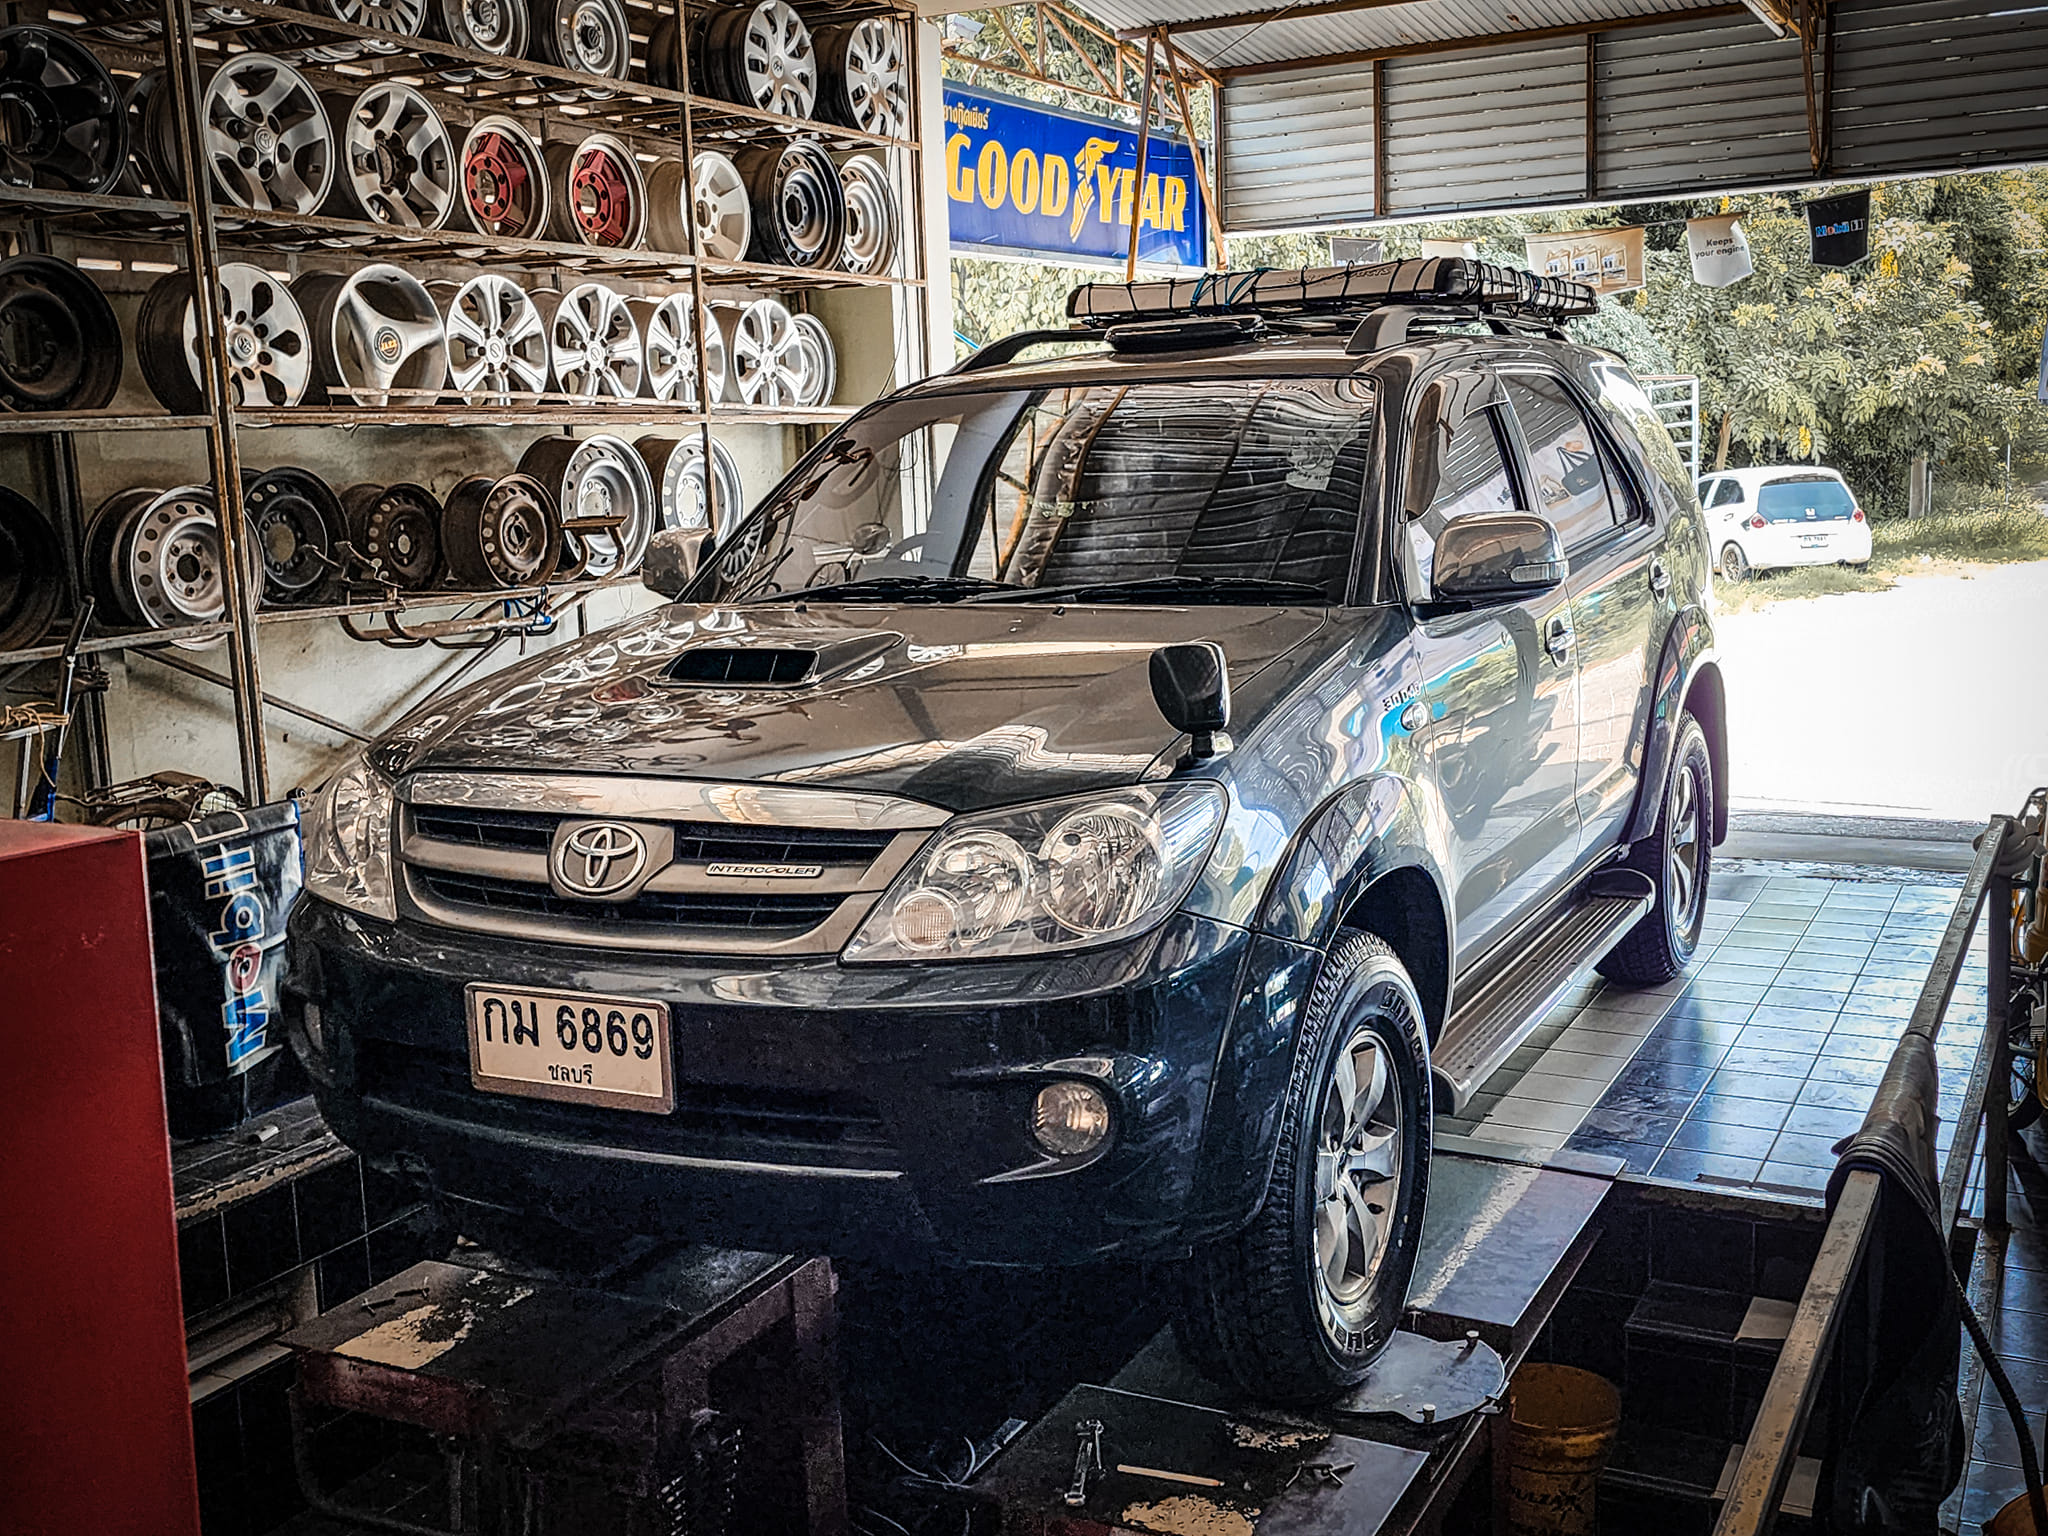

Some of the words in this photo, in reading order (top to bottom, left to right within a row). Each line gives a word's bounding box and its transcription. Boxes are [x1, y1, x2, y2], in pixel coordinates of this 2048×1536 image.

[1816, 221, 1850, 237] Mobil
[1706, 238, 1733, 247] Keeps
[1695, 249, 1714, 260] your
[1716, 244, 1745, 255] engine
[709, 864, 817, 875] INTERCOOLER
[201, 846, 270, 1068] Mobil
[483, 998, 540, 1047] กม
[556, 1005, 654, 1060] 6869
